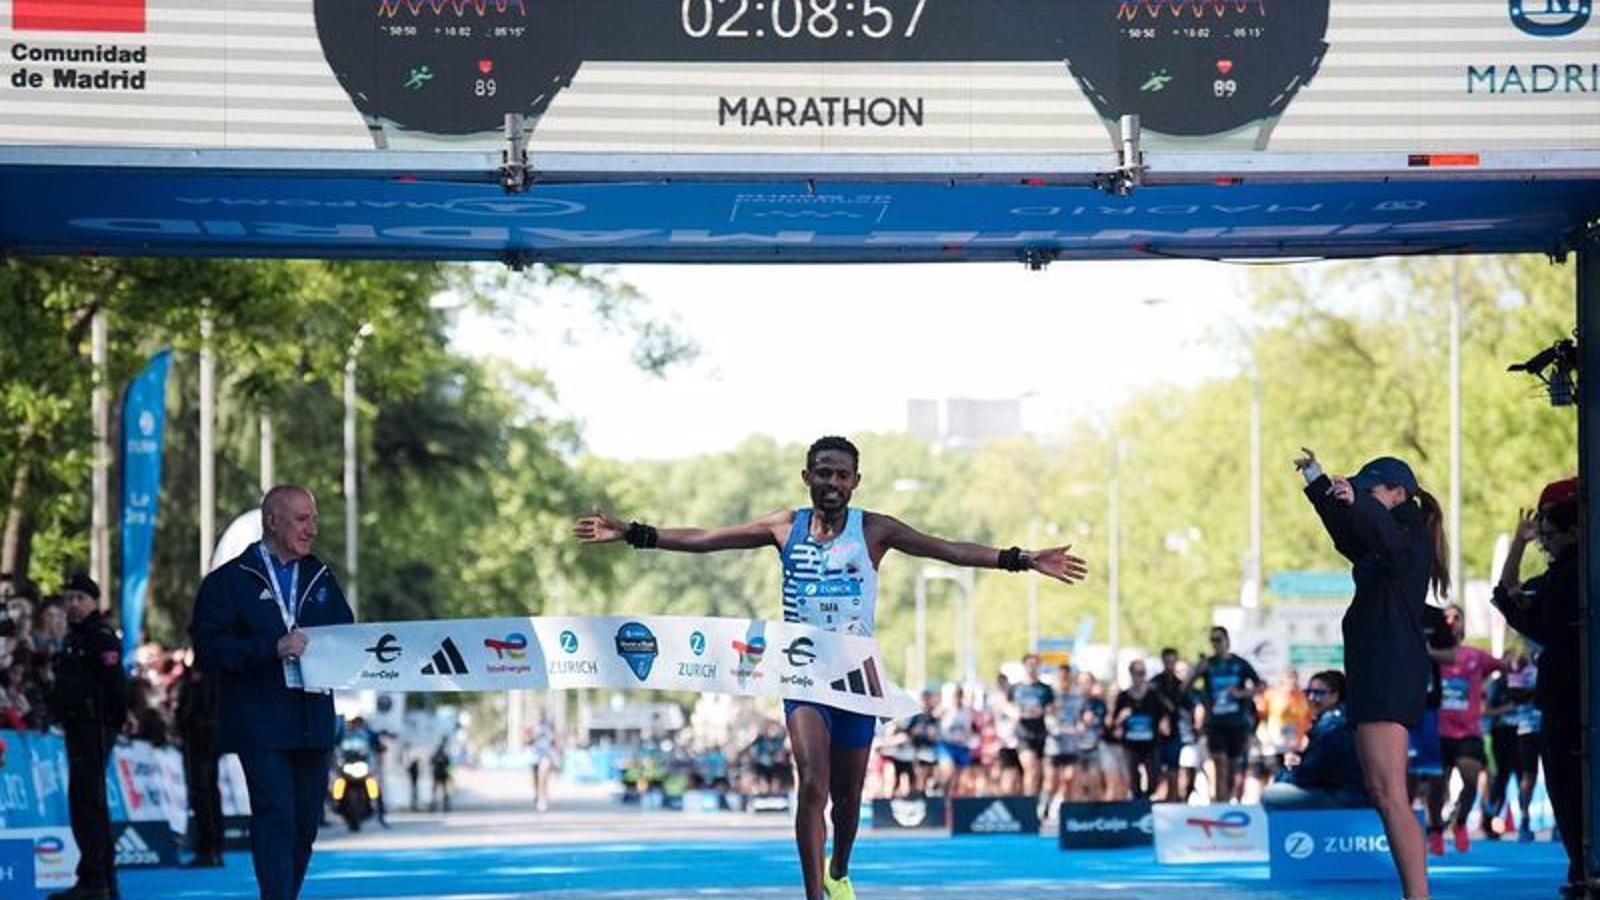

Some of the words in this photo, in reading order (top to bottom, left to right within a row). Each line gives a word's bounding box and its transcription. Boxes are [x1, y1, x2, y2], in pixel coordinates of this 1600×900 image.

[681, 0, 928, 38] 02:08:57
[11, 43, 147, 63] Comunidad
[11, 68, 43, 88] de
[53, 68, 146, 89] Madrid
[474, 79, 497, 97] 89
[1213, 79, 1237, 97] 89
[1467, 63, 1598, 94] MADRI
[718, 97, 924, 127] MARATHON
[1010, 202, 1323, 214] MADRID
[67, 218, 816, 242] MADRID
[549, 660, 598, 674] ZURICH
[677, 662, 716, 679] ZURICH
